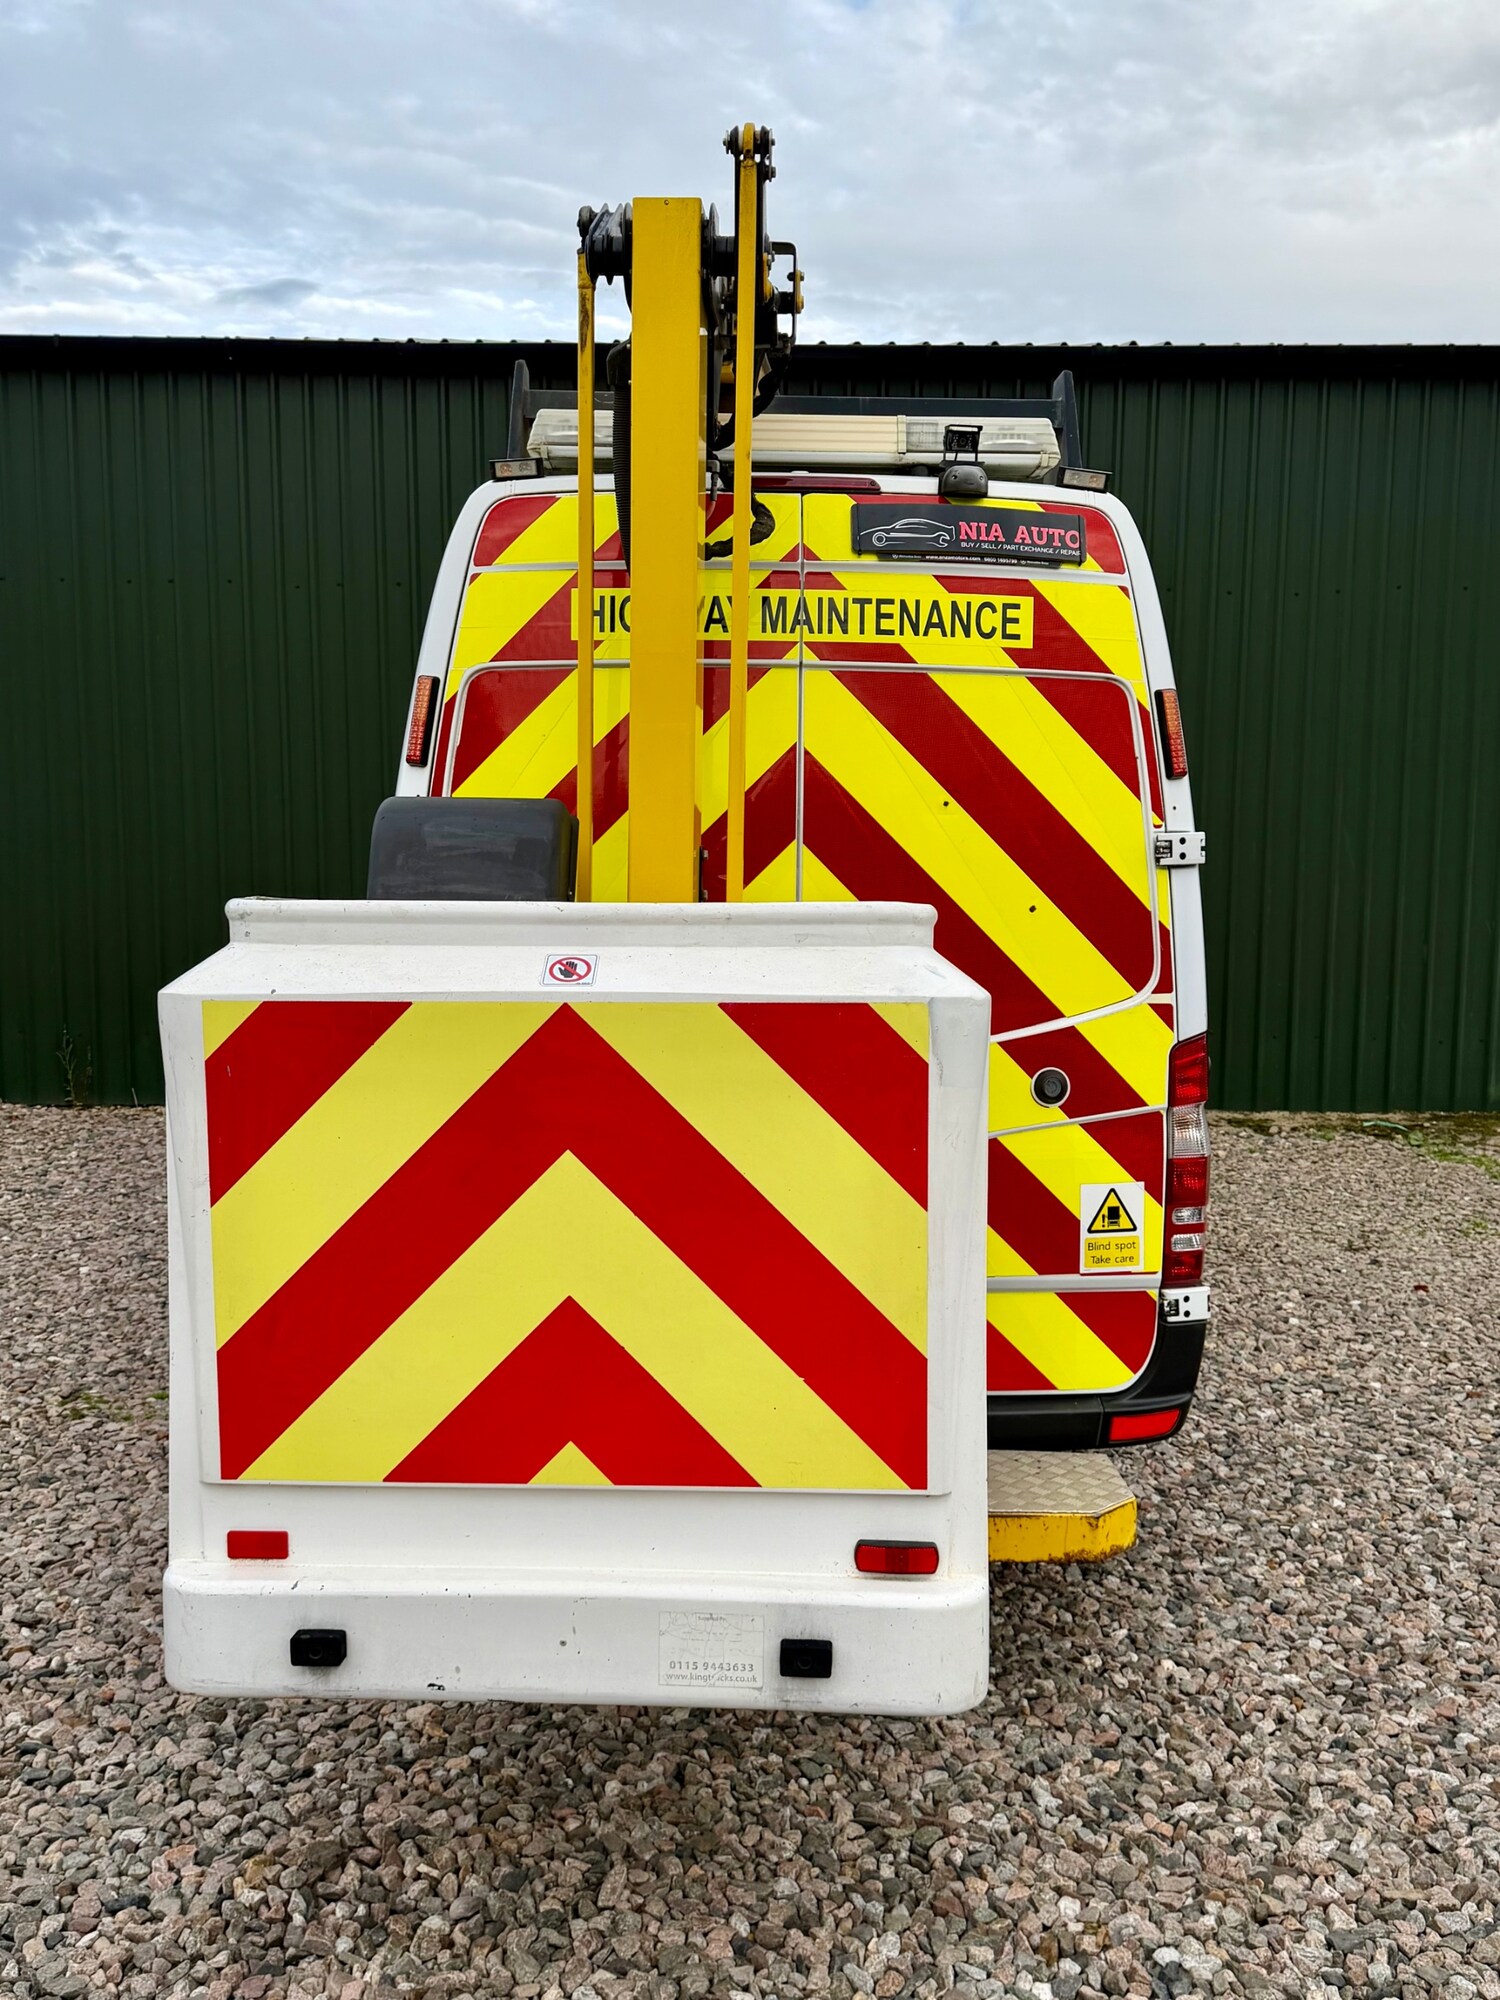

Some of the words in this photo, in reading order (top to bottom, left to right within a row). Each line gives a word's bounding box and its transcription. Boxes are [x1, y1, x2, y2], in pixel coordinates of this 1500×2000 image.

[958, 521, 1005, 542] NIA
[1015, 525, 1080, 549] AUTO
[1020, 545, 1054, 554] EXCHANGE
[761, 596, 1021, 640] MAINTENANCE
[1088, 1241, 1111, 1251] Blind
[1115, 1241, 1136, 1252] spot
[1091, 1255, 1111, 1264] Take
[1115, 1255, 1134, 1263] care
[669, 1660, 698, 1671] 0115
[703, 1661, 754, 1672] 9443633
